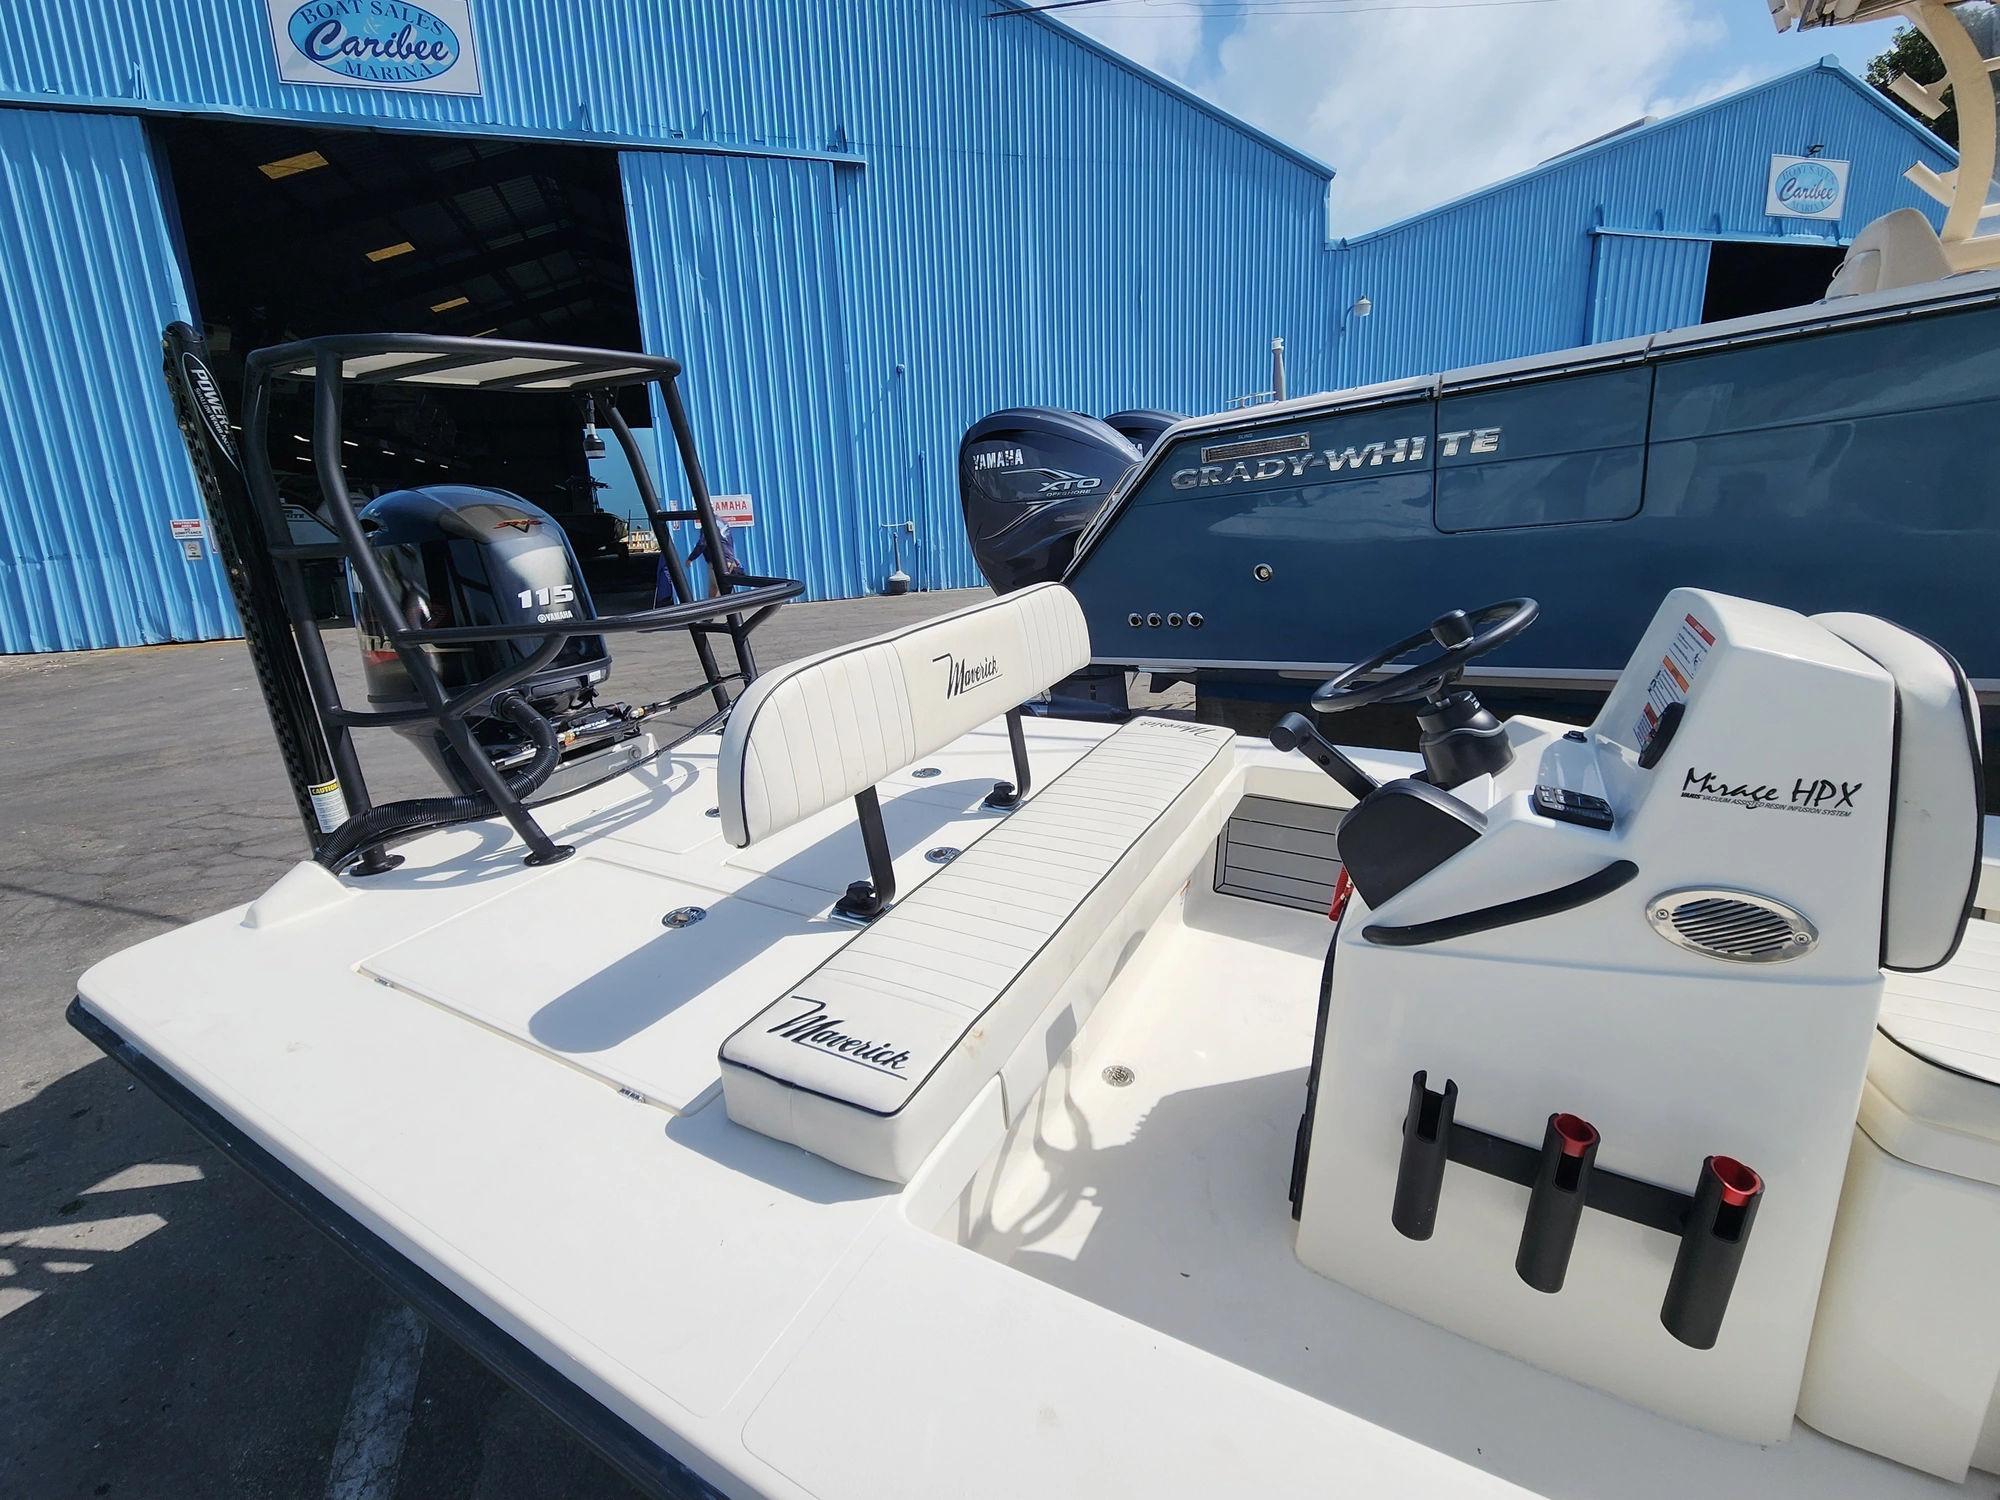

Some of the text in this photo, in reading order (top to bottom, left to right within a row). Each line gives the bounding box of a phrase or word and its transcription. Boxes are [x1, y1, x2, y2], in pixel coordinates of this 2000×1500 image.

[300, 0, 445, 36] BOAT SALES
[304, 19, 450, 62] Caribee
[345, 60, 433, 81] MARINA
[1780, 177, 1834, 202] Caribee
[972, 448, 1024, 471] YAMAHA
[1170, 427, 1502, 490] GRADY-WHITE
[1038, 477, 1102, 493] XTO
[1046, 489, 1092, 497] OFFSHORE
[715, 500, 748, 511] AMAHA
[518, 584, 575, 609] 115
[545, 610, 574, 622] YAMAHA
[932, 653, 1003, 700] Maverick
[1682, 767, 1863, 809] Mirage HPX
[1702, 795, 1731, 803] VACUUM
[1731, 799, 1765, 808] ASSISTED
[1764, 802, 1787, 810] RESIN
[1786, 804, 1822, 814] INFUSION
[1821, 809, 1852, 817] SYSTEM
[766, 995, 911, 1071] Maverick
